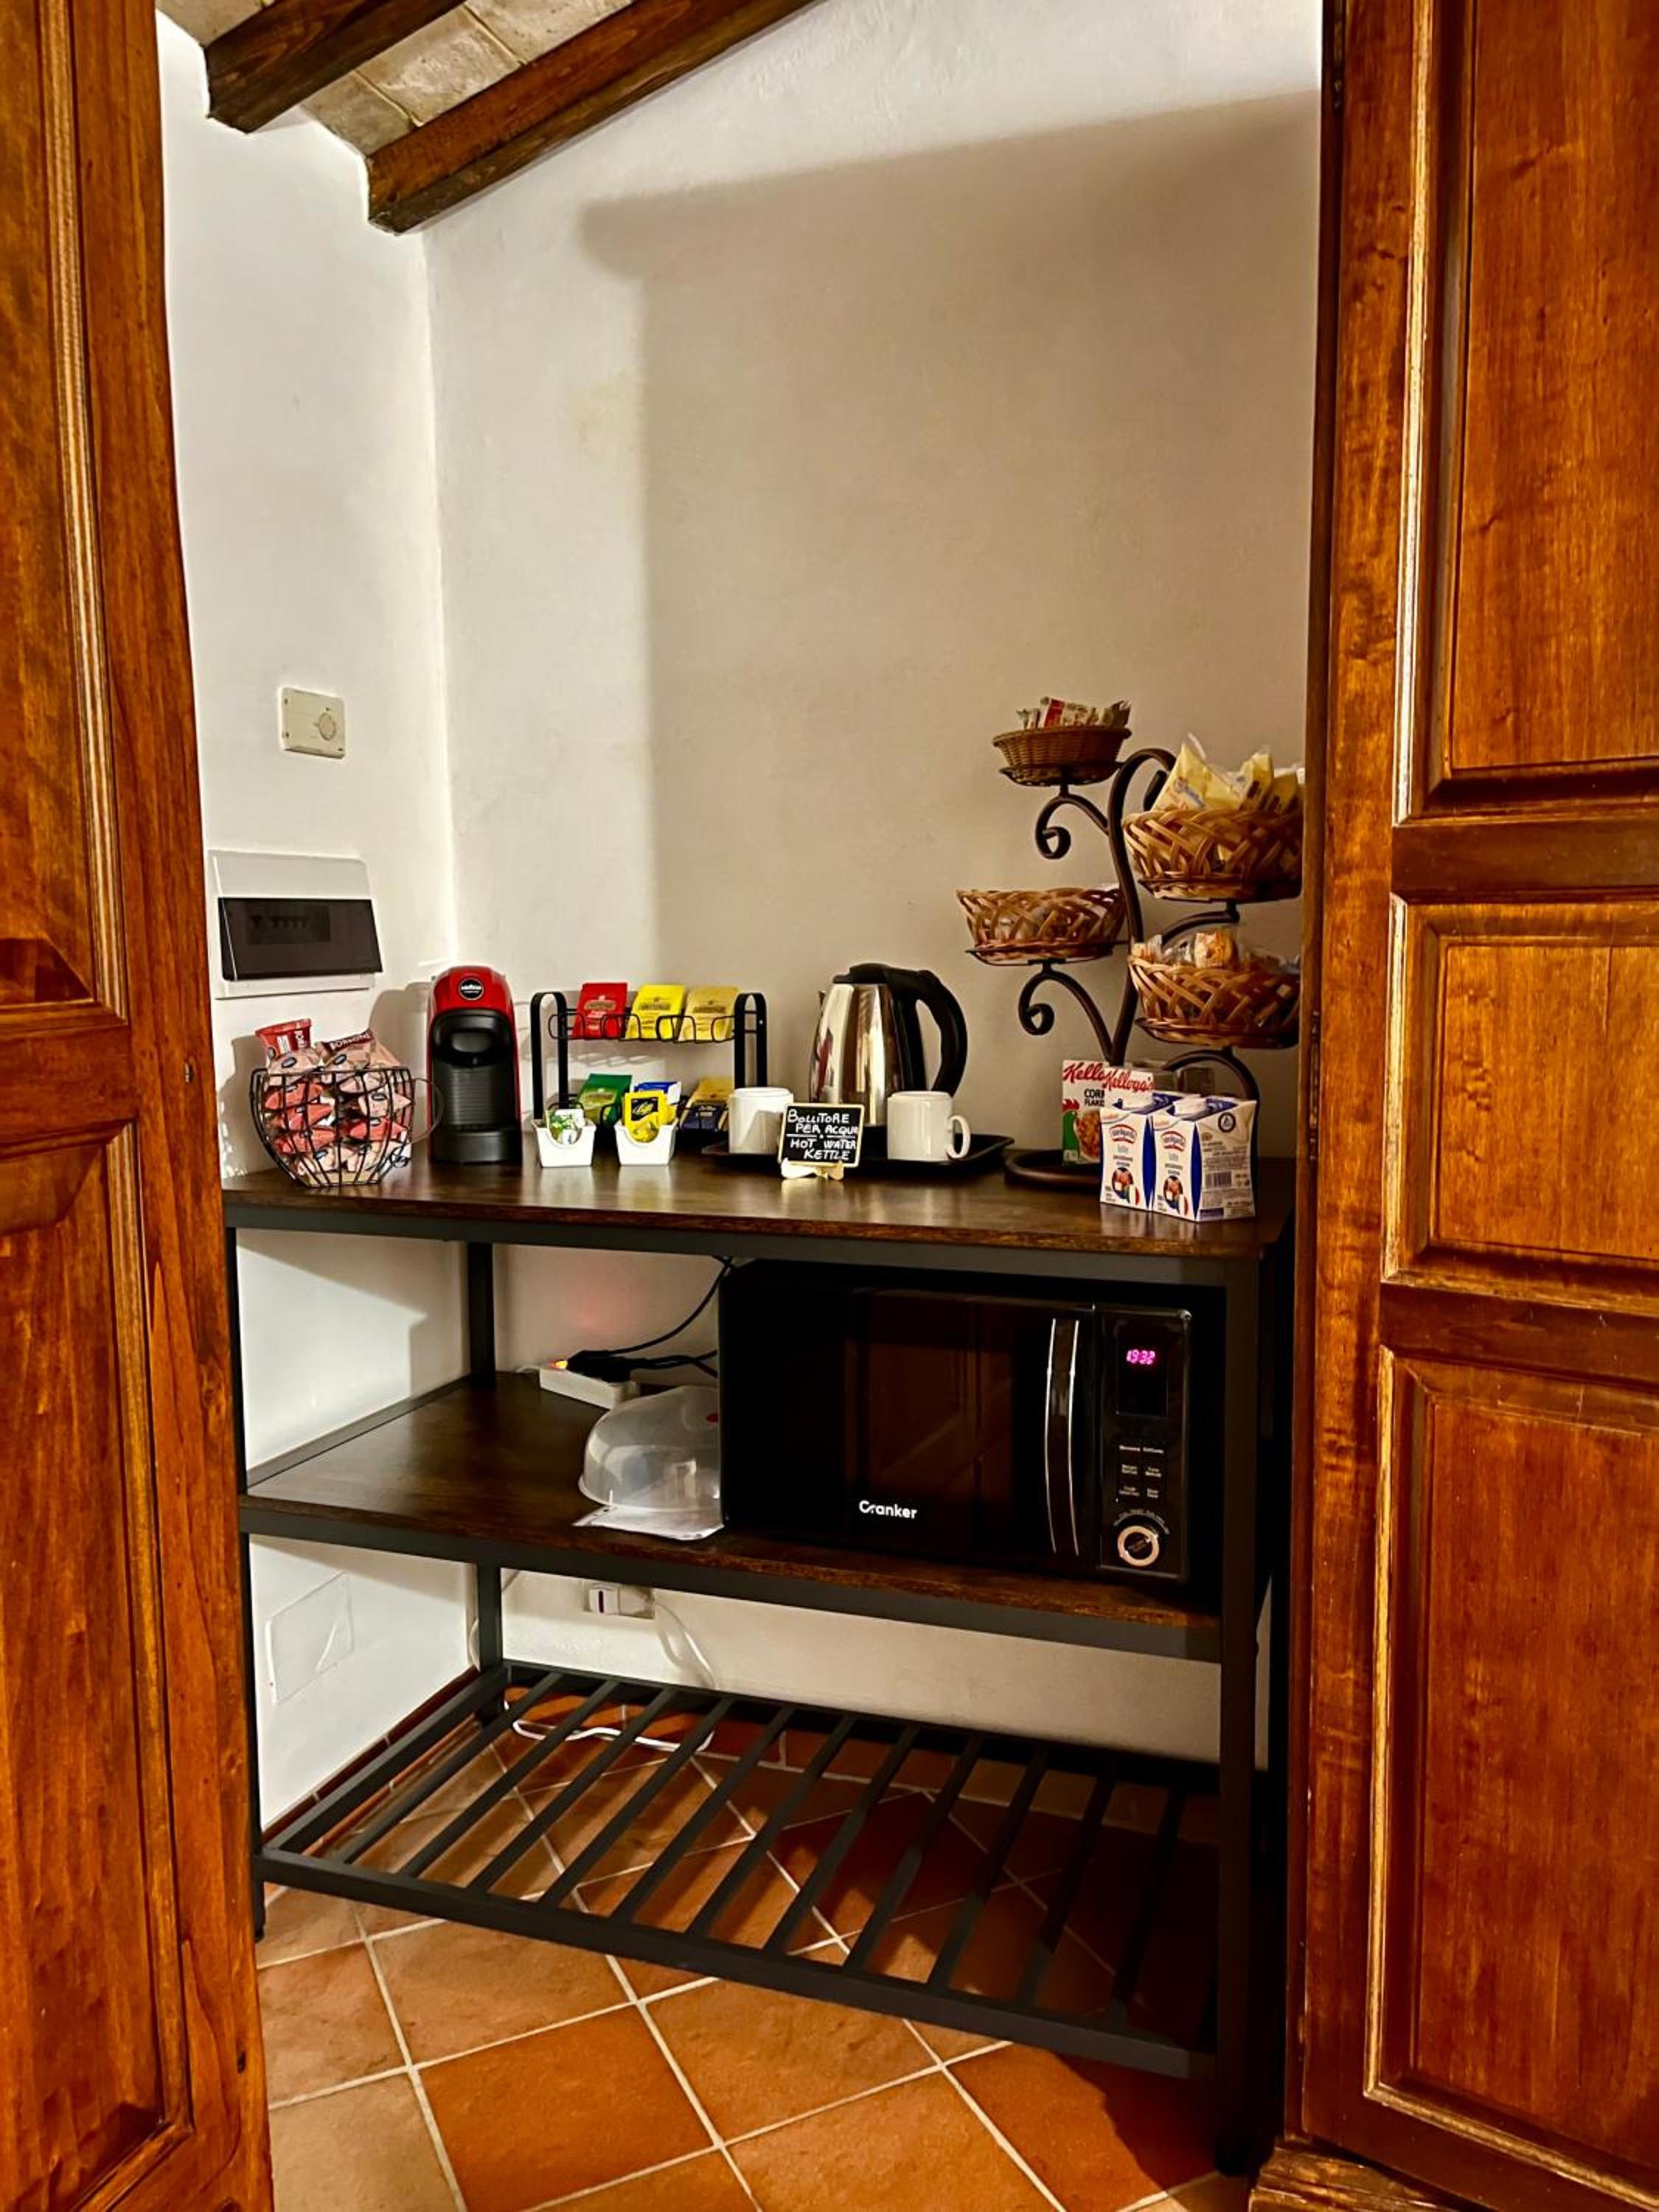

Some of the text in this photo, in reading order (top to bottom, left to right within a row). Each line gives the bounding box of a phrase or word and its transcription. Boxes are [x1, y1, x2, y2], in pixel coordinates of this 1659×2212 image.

[1062, 1062, 1105, 1083] Kello
[796, 1123, 821, 1133] PER
[790, 1138, 855, 1149] HOT WATER
[804, 1149, 849, 1160] KETTLE
[859, 1500, 917, 1519] Cranker
